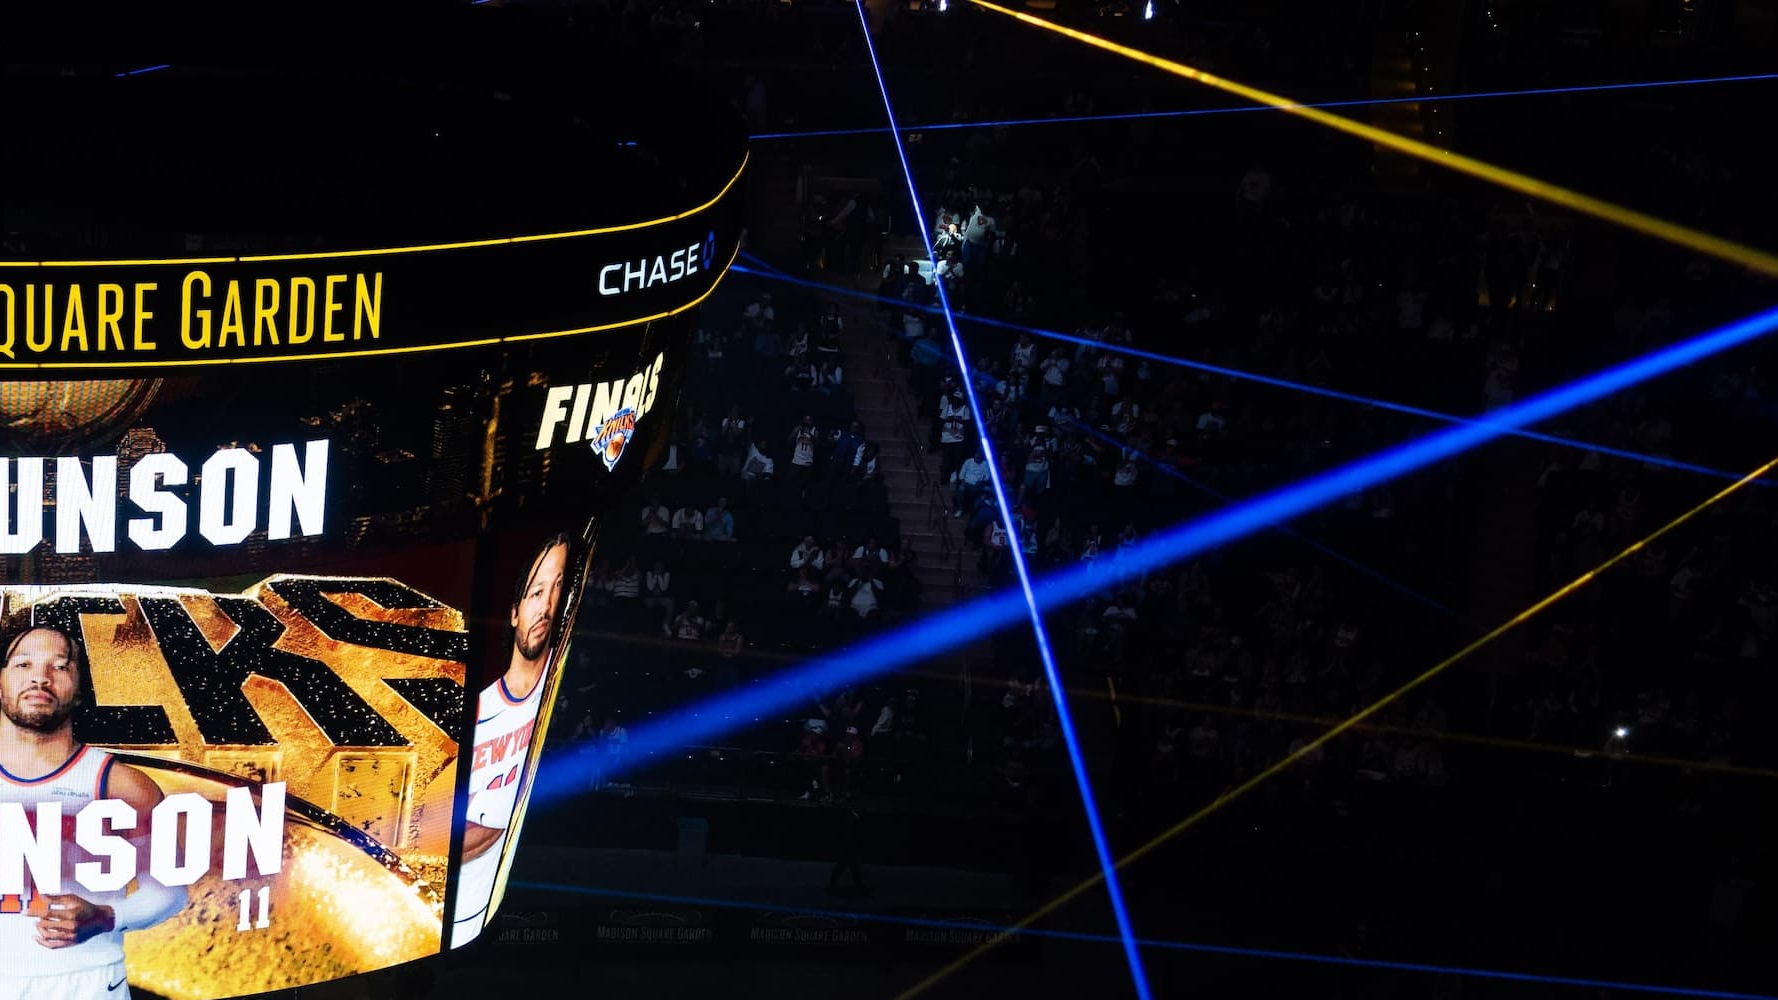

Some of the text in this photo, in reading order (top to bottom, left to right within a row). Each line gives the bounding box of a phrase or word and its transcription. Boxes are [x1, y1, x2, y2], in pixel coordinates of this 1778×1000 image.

[598, 242, 700, 296] CHASE
[180, 270, 383, 349] GARDEN
[535, 351, 664, 451] FINALS
[472, 732, 513, 772] EW
[237, 886, 271, 932] 11
